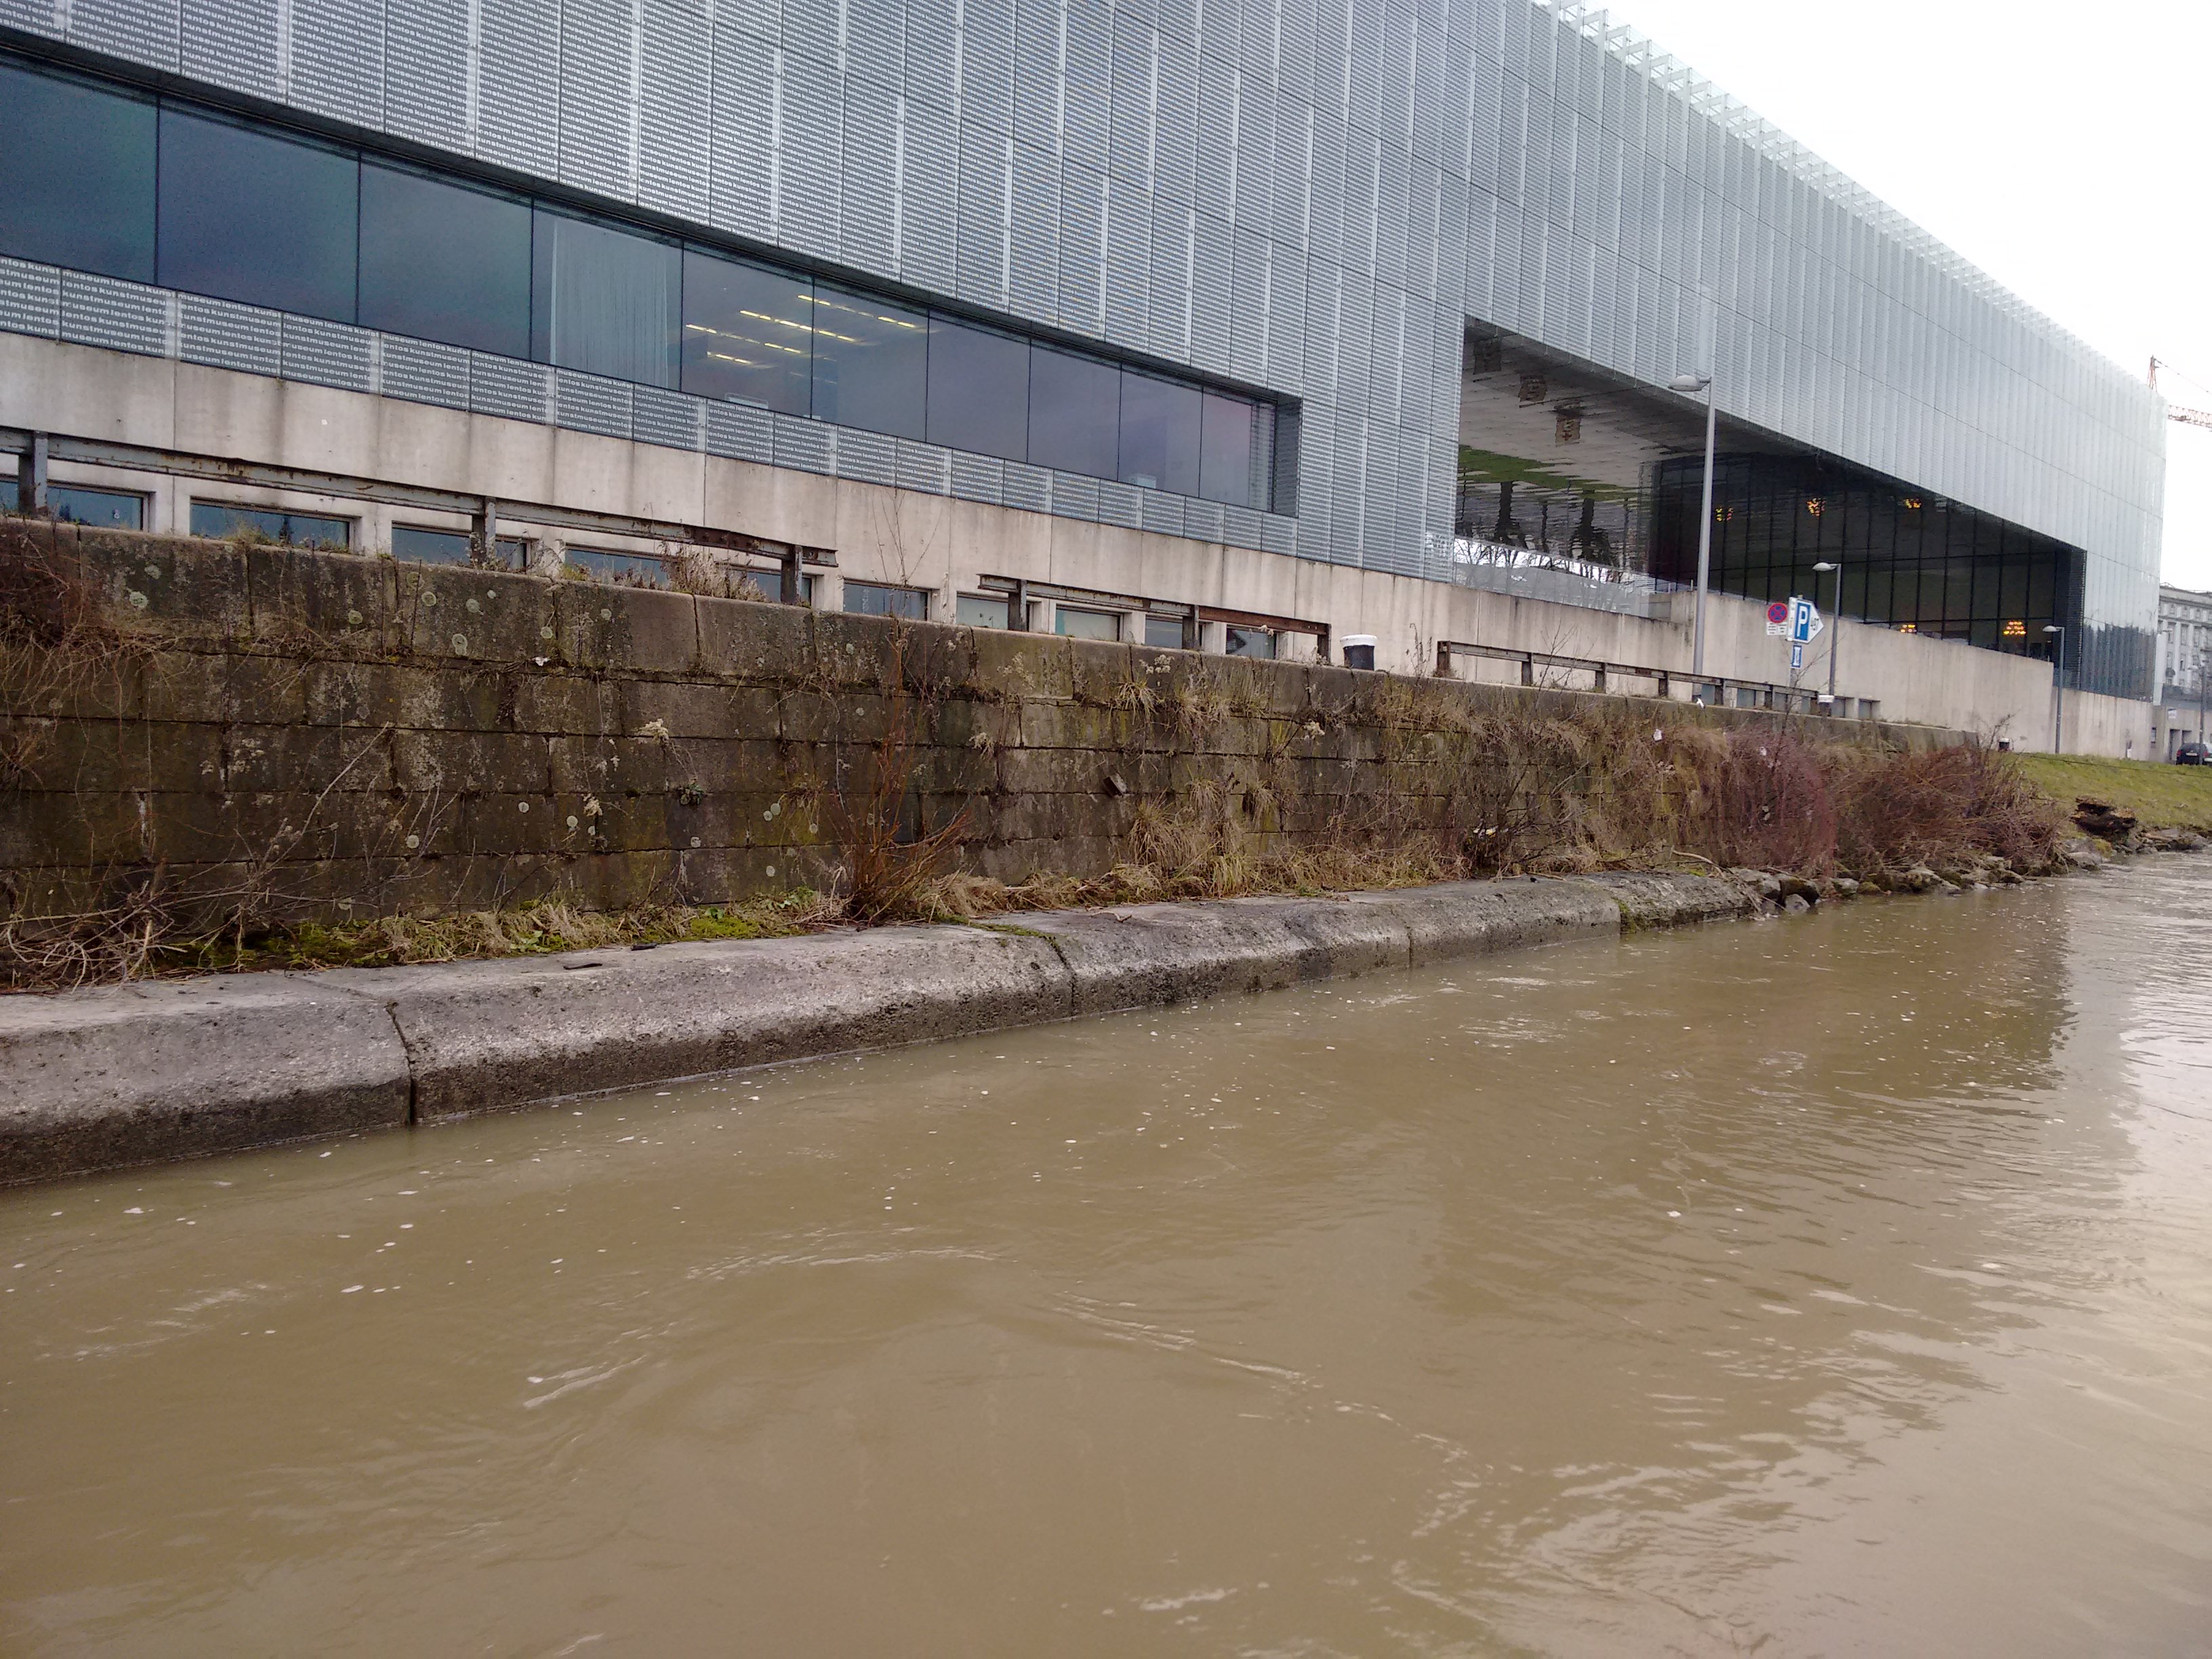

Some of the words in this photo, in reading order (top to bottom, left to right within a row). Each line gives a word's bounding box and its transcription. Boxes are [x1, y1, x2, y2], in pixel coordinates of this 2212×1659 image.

[68, 26, 114, 45] museum
[116, 40, 148, 56] lentos
[150, 50, 180, 65] kunst
[67, 35, 102, 52] lentos
[104, 46, 179, 74] kunstmuseum
[1, 258, 26, 269] ntos
[27, 262, 60, 274] kunst
[0, 268, 60, 285] stmuseum
[62, 270, 109, 285] museum
[111, 279, 144, 292] lentos
[146, 285, 176, 298] kunst
[23, 282, 59, 295] lentos
[62, 279, 98, 293] lentos
[1, 289, 26, 300] ntos
[62, 289, 140, 311] kunstmuseum
[0, 299, 59, 315] stmuseum
[178, 293, 220, 307] museum
[222, 301, 252, 313] lentos
[254, 307, 281, 319] kunst
[23, 314, 59, 326] lentos
[62, 310, 97, 323] lentos
[110, 308, 144, 321] lentos
[211, 308, 281, 328] kunstmuseum
[1, 320, 26, 330] ntos
[27, 323, 59, 335] kunst
[62, 320, 140, 340] kunstmuseum
[250, 325, 280, 337] lentos
[283, 314, 322, 327] museum
[324, 321, 352, 333] lentos
[353, 327, 379, 337] kunst
[283, 323, 312, 335] lentos
[62, 331, 108, 345] museum
[110, 338, 143, 351] lentos
[222, 329, 252, 342] lentos
[283, 332, 348, 350] kunstmuseum
[211, 337, 280, 356] kunstmuseum
[381, 333, 417, 346] museum
[419, 340, 445, 352] lentos
[447, 346, 470, 356] kunst
[250, 353, 280, 365] lentos
[283, 350, 312, 362] lentos
[323, 348, 351, 360] lentos
[410, 347, 470, 365] kunstmuseum
[221, 358, 251, 369] lentos
[253, 363, 280, 375] kunst
[283, 359, 348, 377] kunstmuseum
[443, 362, 469, 373] lentos
[472, 352, 506, 364] museum
[507, 358, 531, 369] lentos
[533, 363, 554, 373] kunst
[472, 359, 497, 371] lentos
[283, 369, 321, 382] museum
[323, 375, 351, 387] lentos
[419, 366, 445, 377] lentos
[472, 368, 528, 385] kunstmuseum
[556, 369, 588, 380] museum
[590, 375, 612, 386] lentos
[613, 380, 633, 390] kunst
[409, 373, 469, 390] kunstmuseum
[506, 383, 531, 394] lentos
[443, 388, 469, 399] lentos
[471, 385, 496, 396] lentos
[581, 382, 633, 398] kunstmuseum
[418, 392, 445, 403] lentos
[446, 397, 469, 407] kunst
[471, 394, 528, 410] kunstmuseum
[589, 399, 611, 409] lentos
[611, 395, 632, 406] lentos
[471, 403, 505, 414] museum
[506, 409, 531, 419] lentos
[532, 413, 554, 423] kun
[581, 406, 632, 422] kunstmuseum
[588, 424, 611, 434] lentos
[612, 428, 632, 437] kunst
[610, 419, 632, 430] lentos
[1797, 605, 1808, 637] P
